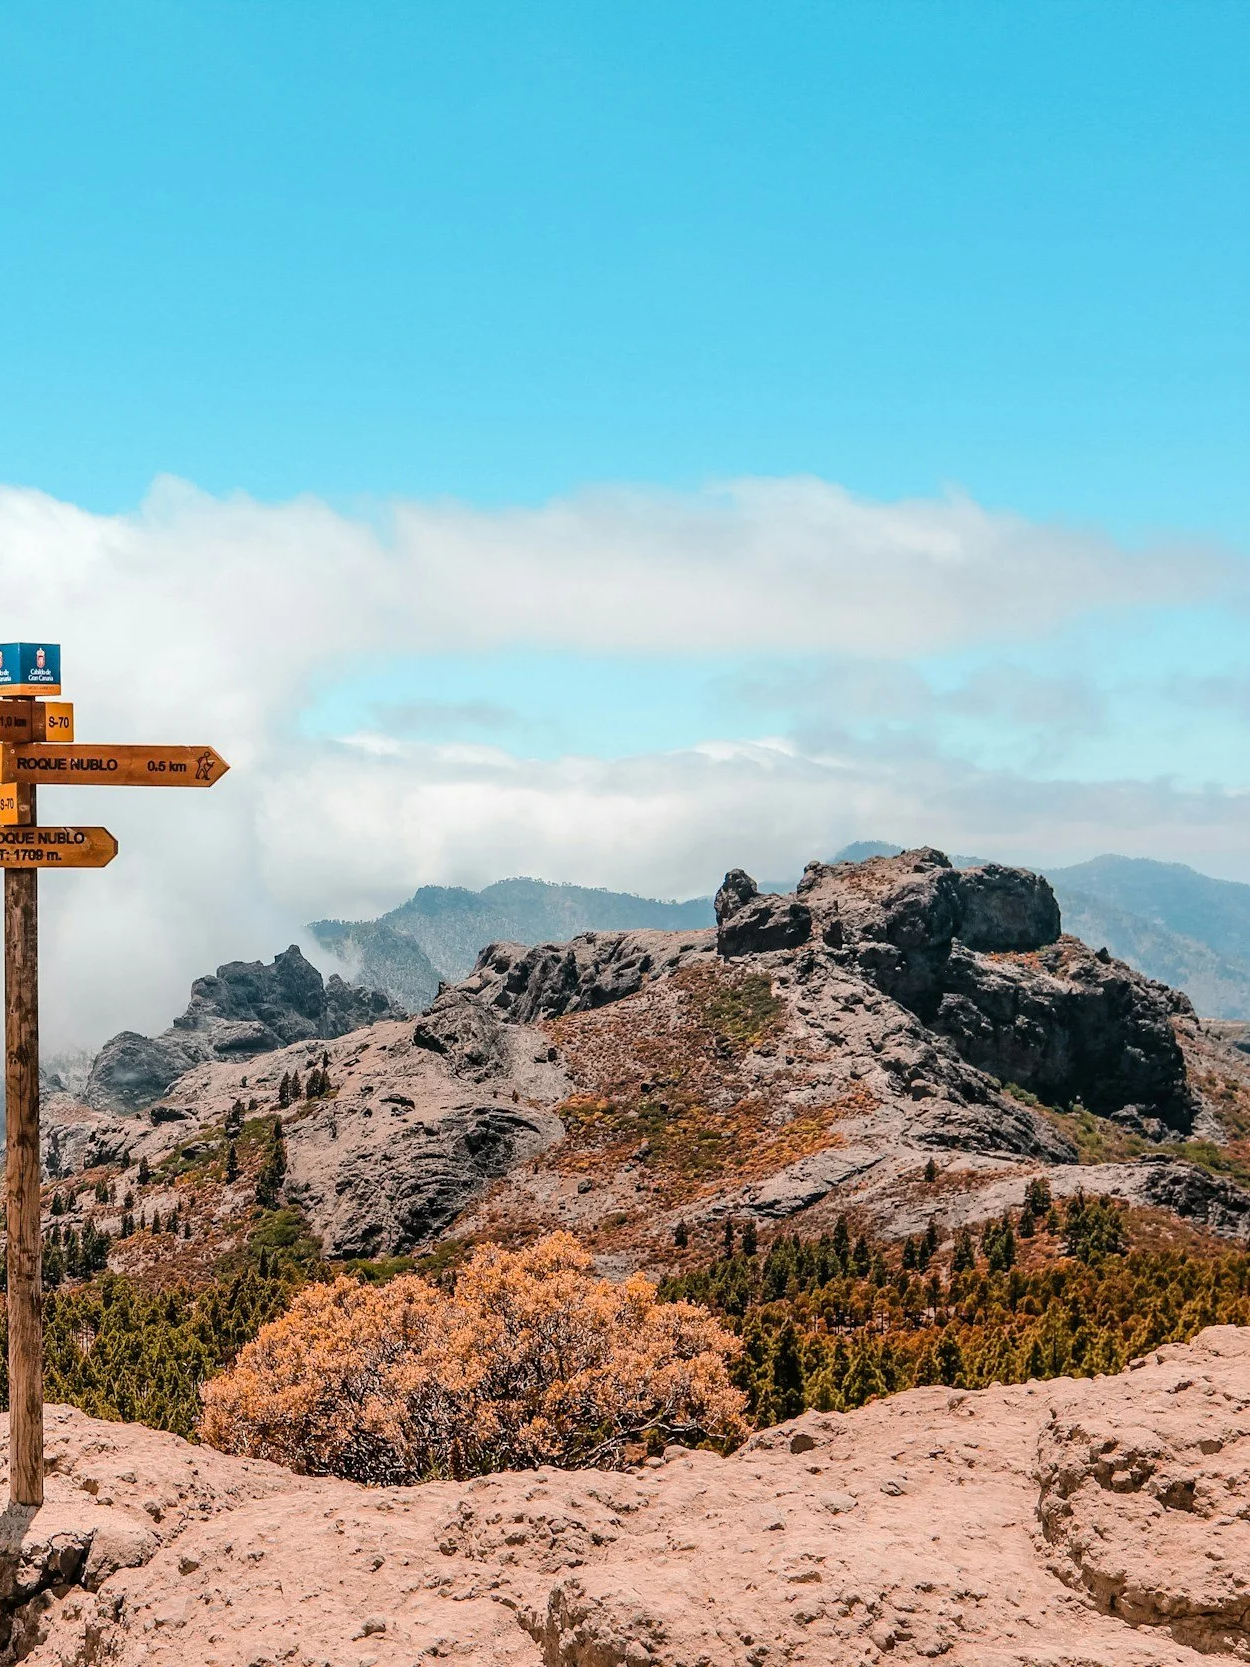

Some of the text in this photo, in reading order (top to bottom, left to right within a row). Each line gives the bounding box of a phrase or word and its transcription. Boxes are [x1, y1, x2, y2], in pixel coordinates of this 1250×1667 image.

[0, 716, 27, 728] 1,0 km
[48, 716, 70, 729] S-70
[17, 758, 118, 771] ROQUE NUBLO
[147, 761, 187, 772] 0.5 km
[0, 797, 14, 811] S-70
[37, 832, 85, 845] NUBLO
[14, 849, 44, 861] 1709
[46, 851, 62, 861] m.
